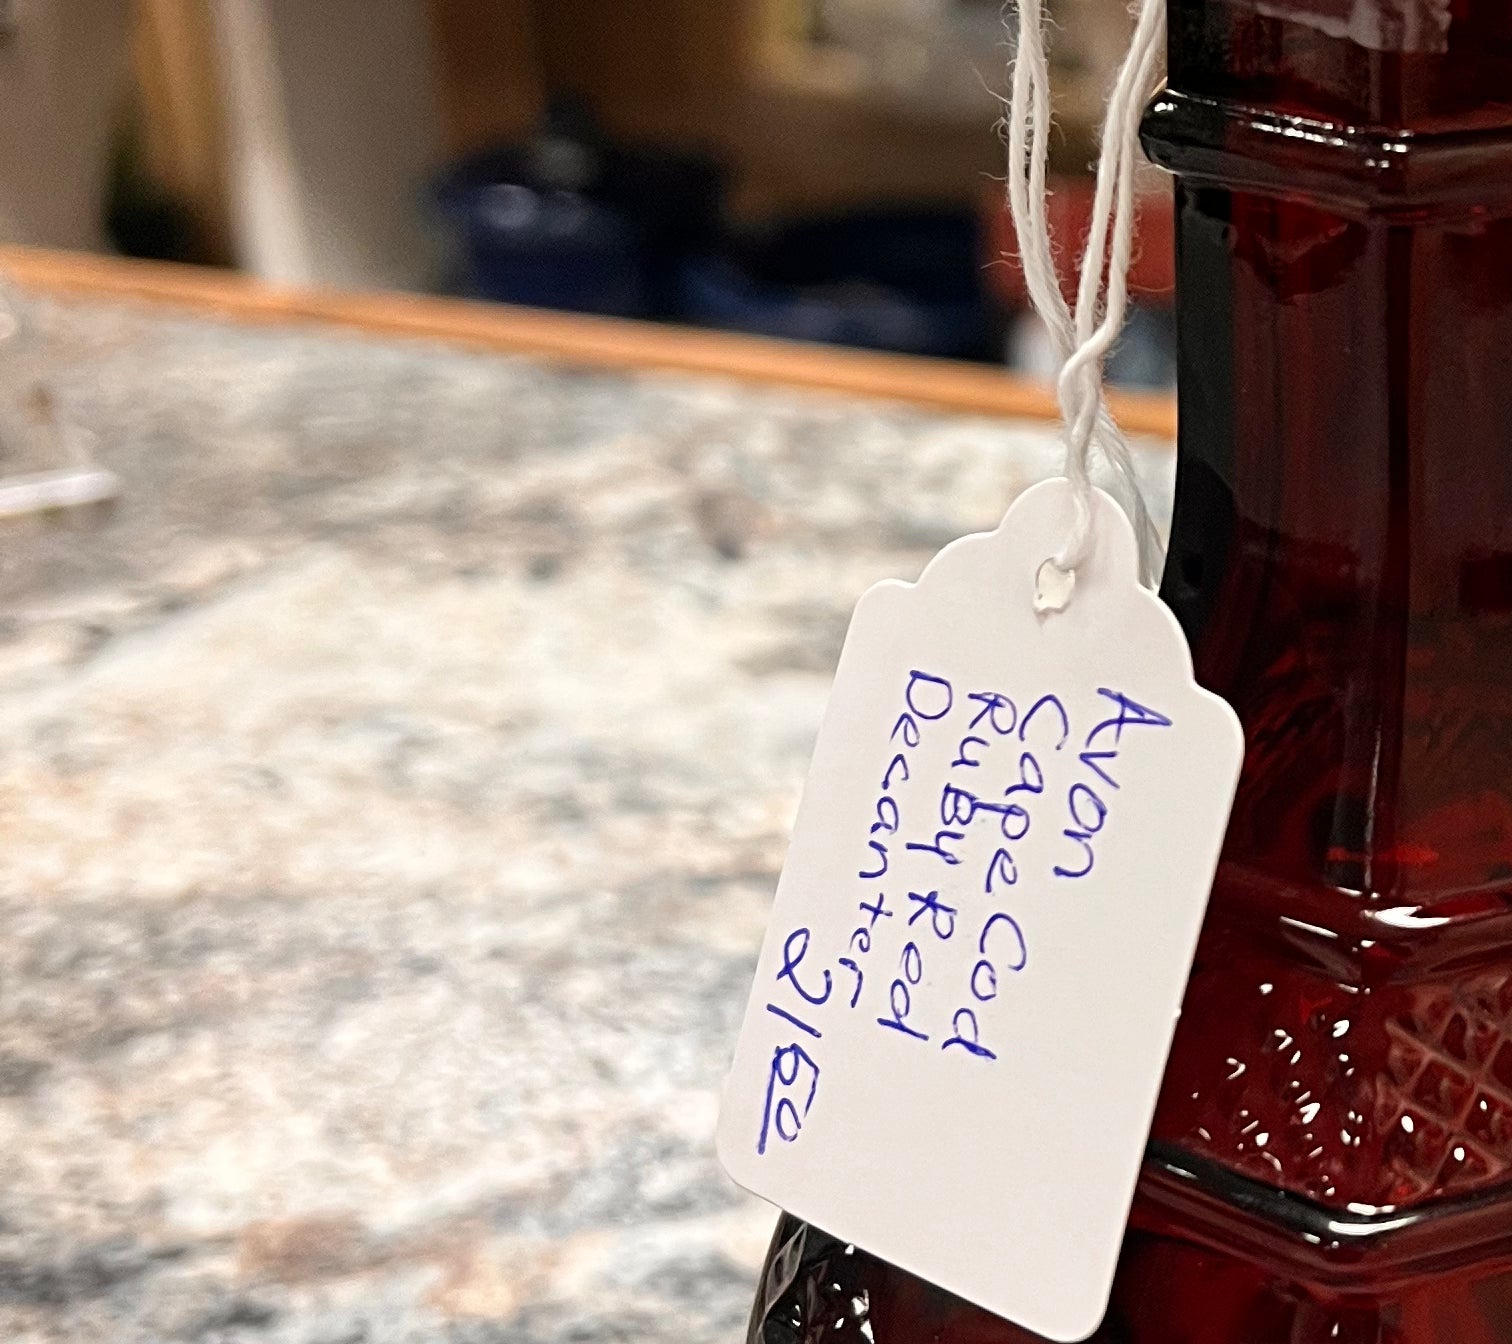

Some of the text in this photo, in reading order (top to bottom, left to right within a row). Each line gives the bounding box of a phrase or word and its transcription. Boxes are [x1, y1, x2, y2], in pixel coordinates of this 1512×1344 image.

[838, 669, 953, 1008] Decanter
[941, 694, 1068, 1061] Cape Cod
[1053, 687, 1172, 880] Avon
[877, 890, 956, 1042] Red
